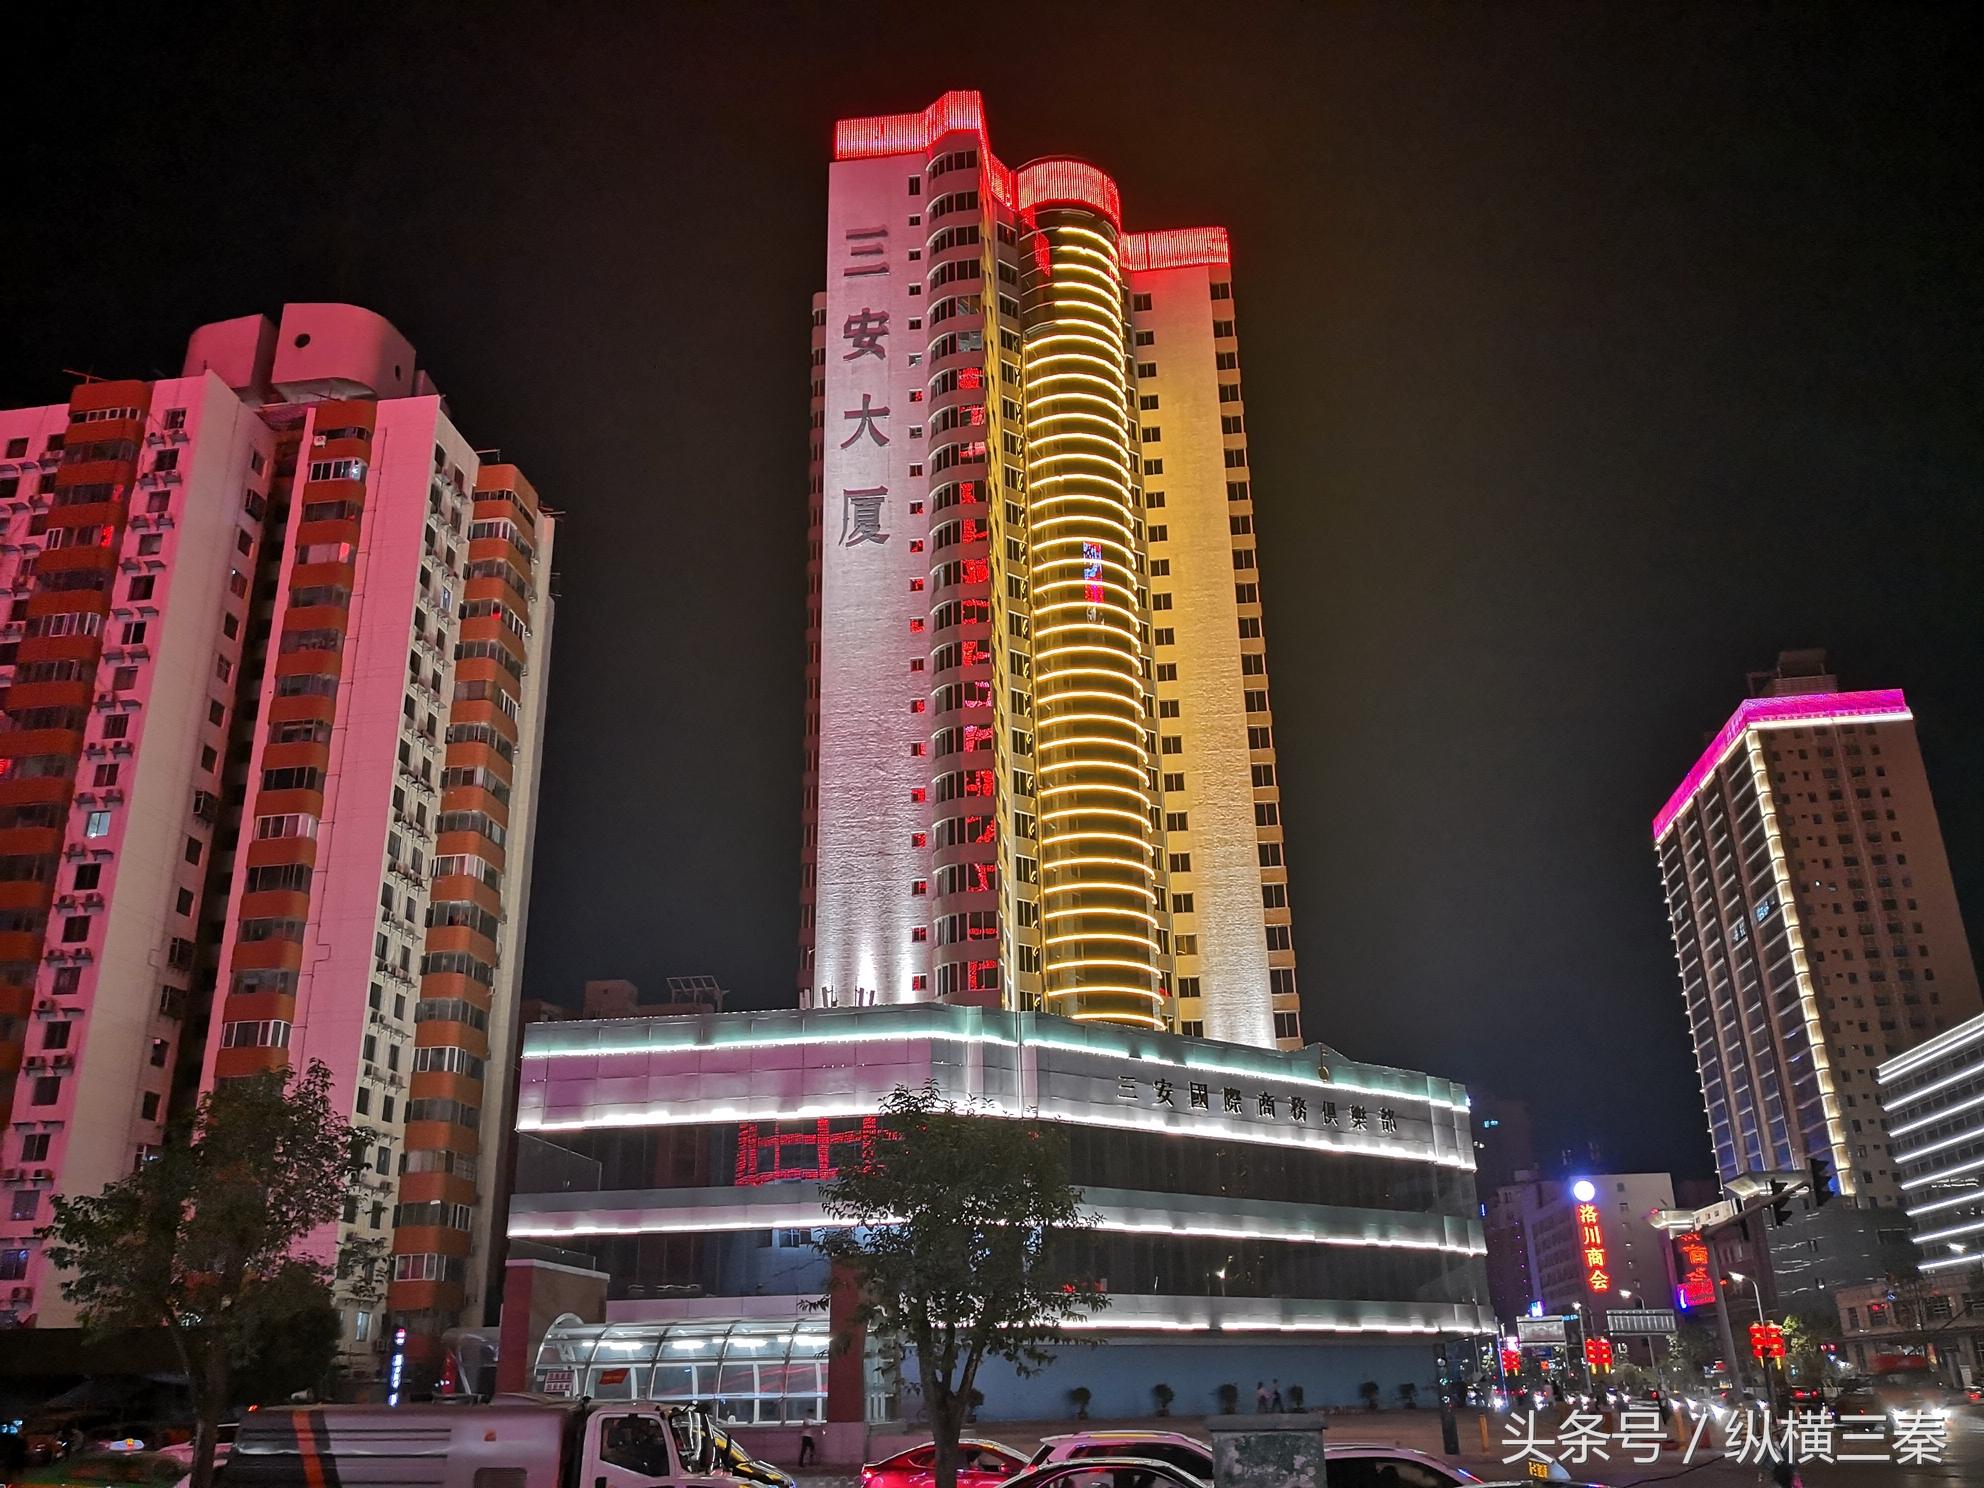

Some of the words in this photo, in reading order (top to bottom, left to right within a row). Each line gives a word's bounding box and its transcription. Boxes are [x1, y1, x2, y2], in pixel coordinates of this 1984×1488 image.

[838, 223, 890, 548] 三安大厦
[1116, 1074, 1398, 1134] 三安國際商務俱樂部
[1578, 1203, 1609, 1290] 洛川商会
